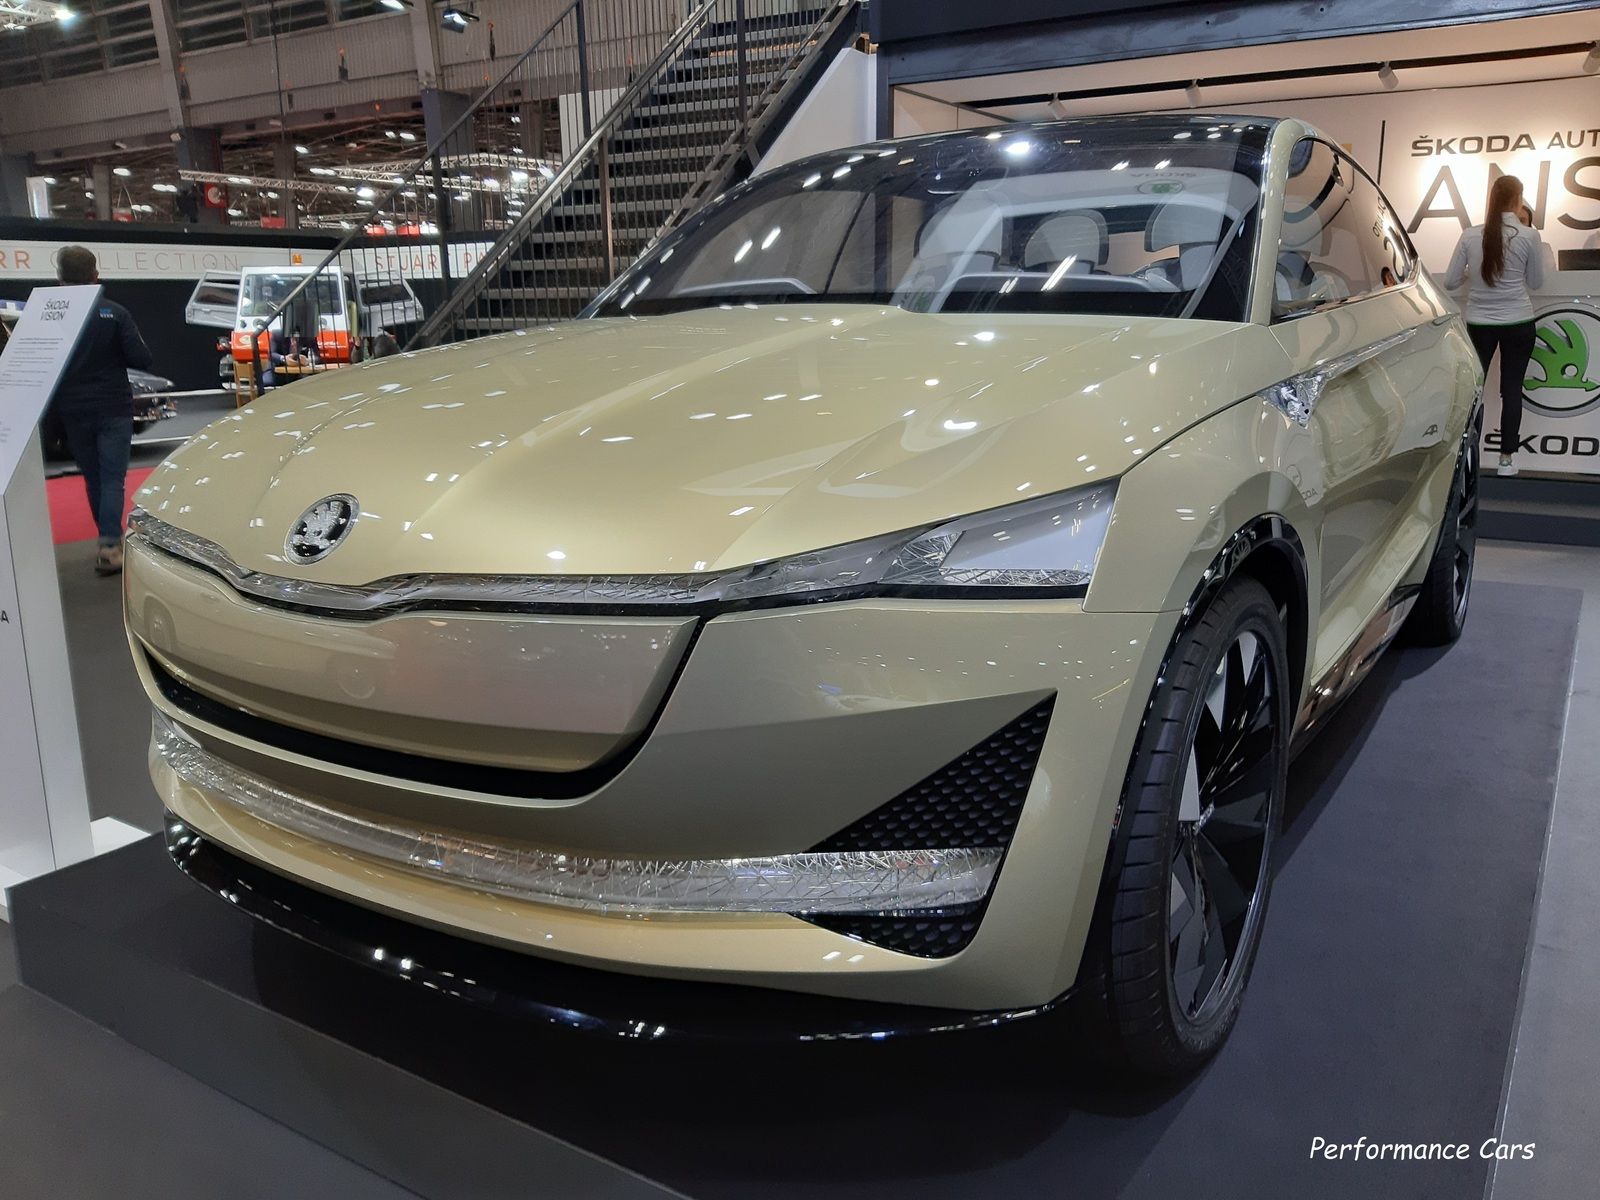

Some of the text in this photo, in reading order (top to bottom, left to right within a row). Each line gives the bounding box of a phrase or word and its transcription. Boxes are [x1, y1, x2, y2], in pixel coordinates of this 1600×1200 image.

[1411, 128, 1600, 157] ŠKODA AUT
[50, 250, 239, 271] CLLECTION
[40, 311, 65, 321] VISION
